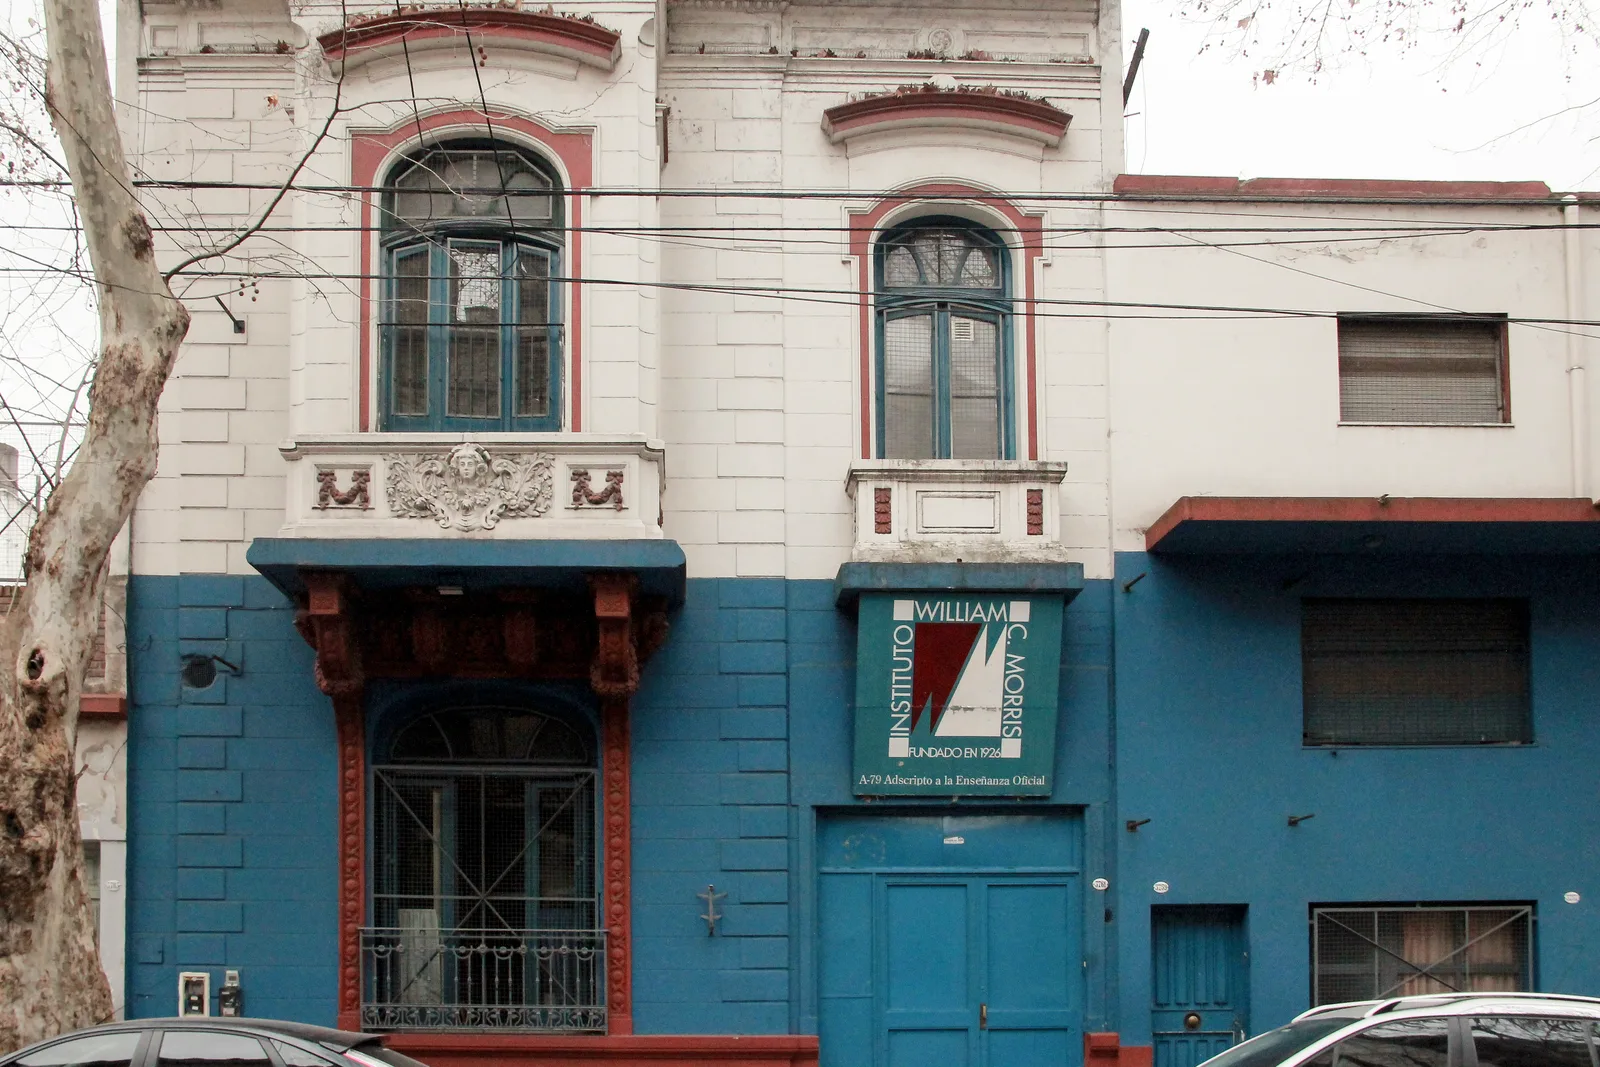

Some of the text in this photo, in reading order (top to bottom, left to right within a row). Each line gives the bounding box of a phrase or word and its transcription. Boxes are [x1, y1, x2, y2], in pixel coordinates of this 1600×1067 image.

[914, 601, 1008, 622] WILLIAM
[890, 625, 914, 736] INSTITUTO
[1002, 624, 1028, 738] C. MORRIS
[909, 747, 1001, 758] FUNDADO EN 1926
[859, 774, 1045, 787] A-79 Adscripto a la Enseñanza Oficial
